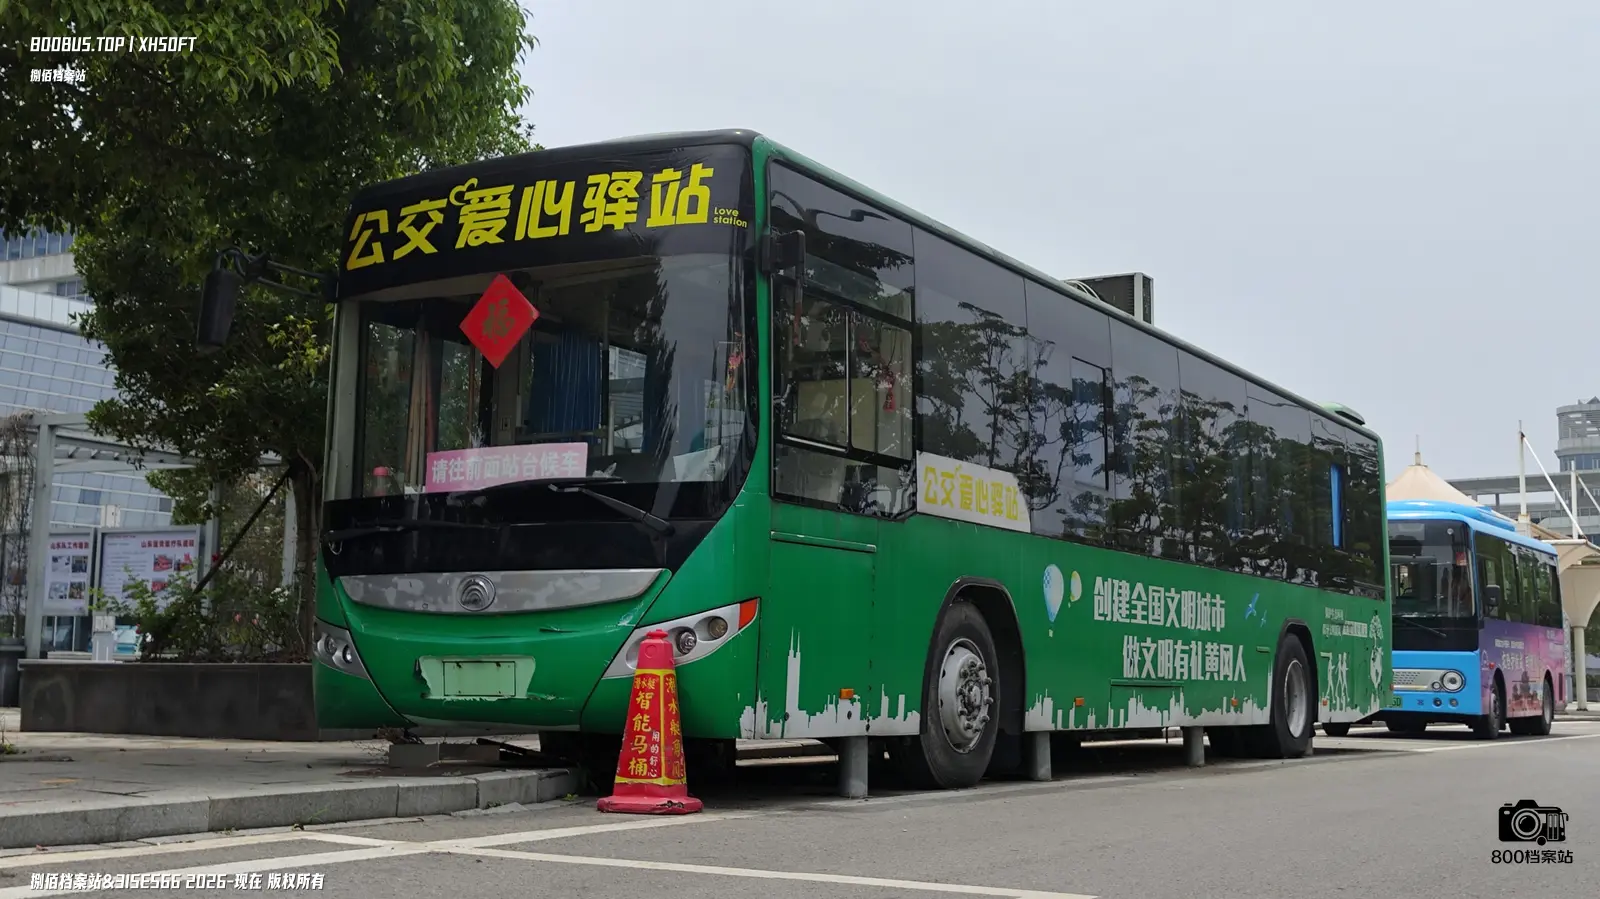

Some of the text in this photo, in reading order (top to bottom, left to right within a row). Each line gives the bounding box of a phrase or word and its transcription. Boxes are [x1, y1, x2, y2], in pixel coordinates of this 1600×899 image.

[346, 163, 714, 271] 公交爱心驿站
[713, 216, 748, 228] station
[714, 206, 739, 216] Love
[482, 298, 516, 344] 福
[431, 450, 582, 484] 请往前面站台候车
[922, 464, 1020, 521] 公交爱心驿站
[1093, 575, 1226, 633] 创建全国文明城市
[1122, 634, 1248, 682] 做文明有礼黄冈人
[628, 691, 654, 776] 智能马桶
